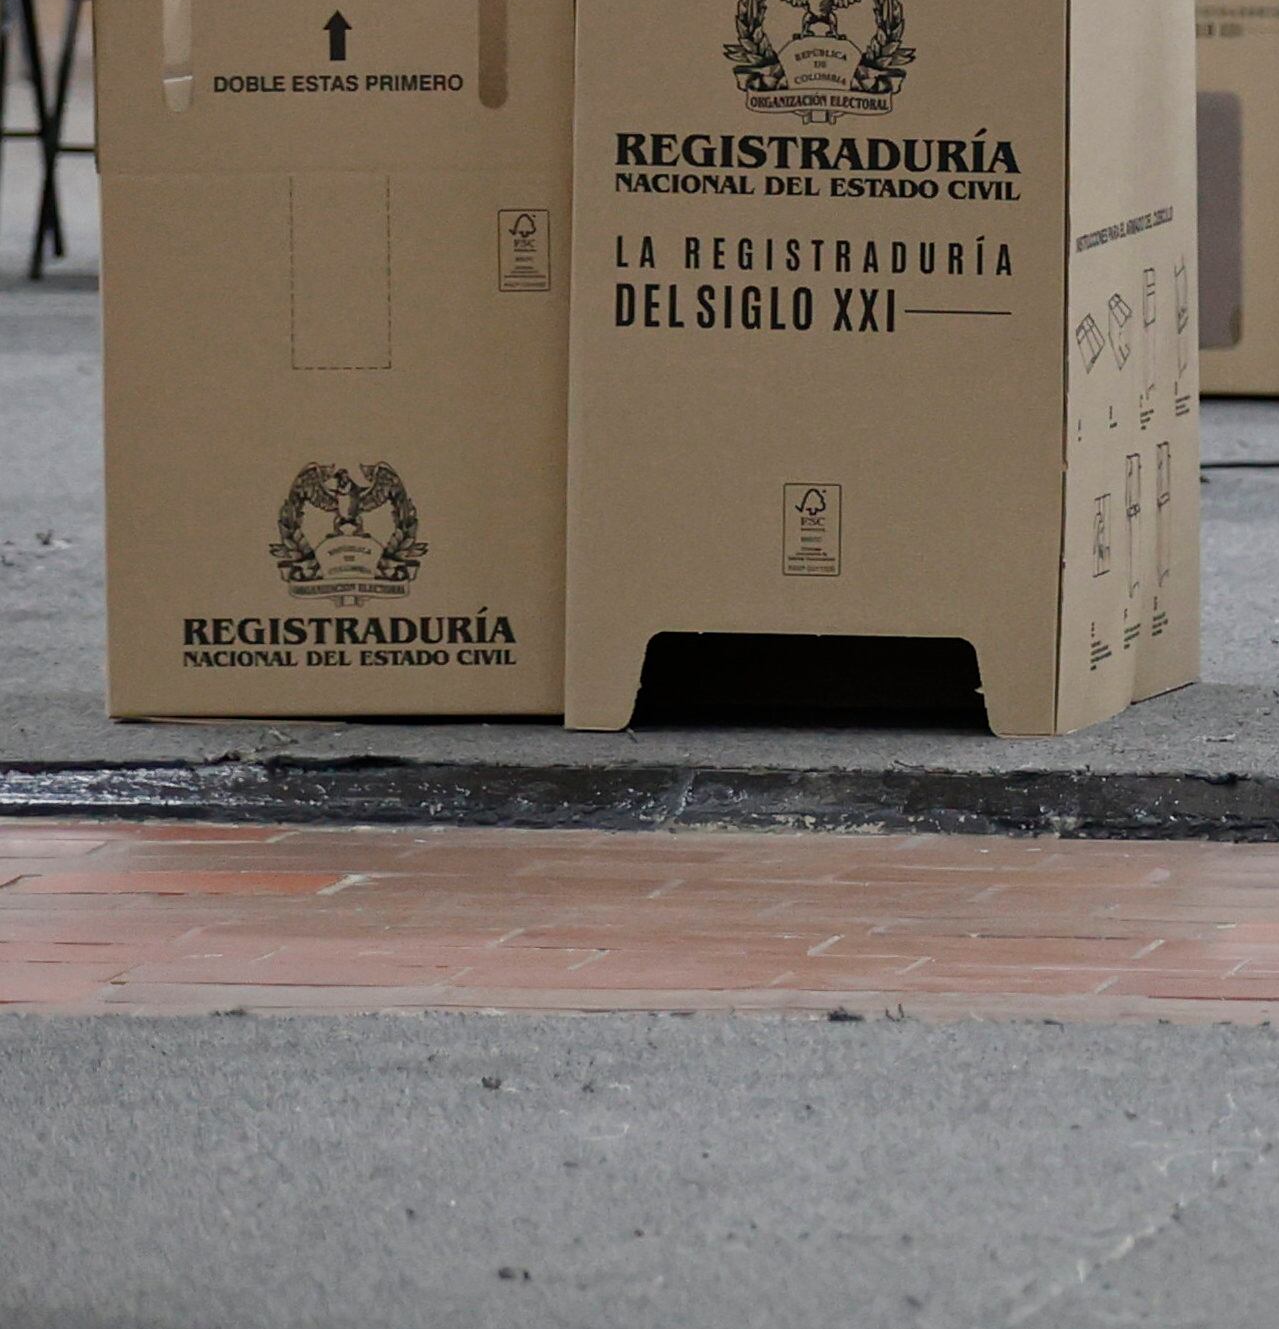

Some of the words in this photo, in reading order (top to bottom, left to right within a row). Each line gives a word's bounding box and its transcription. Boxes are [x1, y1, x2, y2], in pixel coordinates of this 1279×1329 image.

[213, 75, 286, 93] DOBLE
[291, 74, 360, 93] ESTAS
[365, 74, 464, 92] PRIMERO
[830, 94, 890, 111] ELECTORAL
[615, 128, 1022, 174] REGISTRADURÍA
[615, 173, 755, 195] NACIONAL
[764, 175, 820, 197] DEL
[830, 177, 940, 199] ESTADO
[947, 179, 1021, 201] CIVIL
[616, 235, 656, 269] LA
[684, 236, 1012, 277] REGISTRADURÍA
[615, 283, 685, 329] DEL
[696, 284, 813, 331] SIGLO
[832, 288, 896, 333] XXI
[183, 607, 517, 646] REGISTRADURÍA
[183, 650, 299, 668] NACIONAL
[306, 650, 352, 667] DEL
[359, 649, 450, 667] ESTADO
[456, 648, 517, 666] CIVIL
